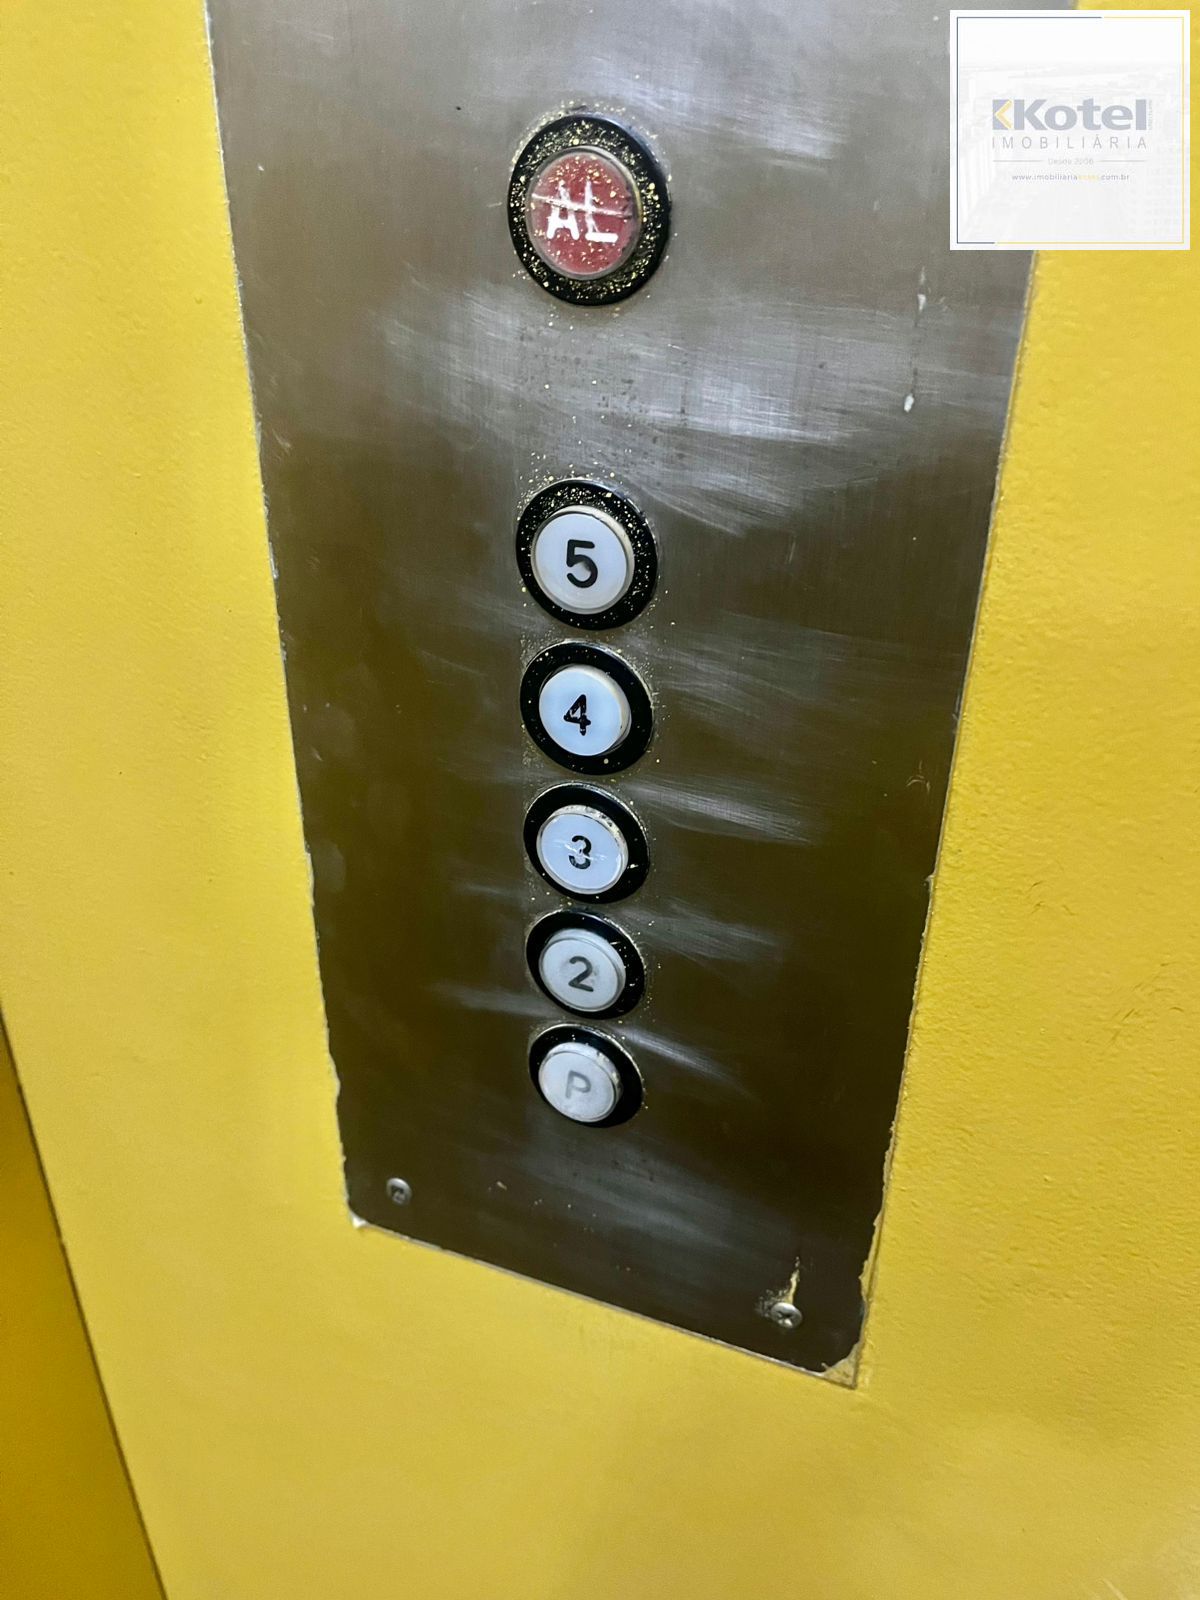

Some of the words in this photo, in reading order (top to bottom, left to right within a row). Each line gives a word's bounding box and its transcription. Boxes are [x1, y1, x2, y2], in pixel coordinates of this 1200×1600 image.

[546, 180, 619, 243] AL
[566, 539, 598, 588] 5
[562, 694, 591, 736] 4
[568, 835, 592, 870] 3
[568, 956, 594, 993] 2
[565, 1070, 591, 1099] P
